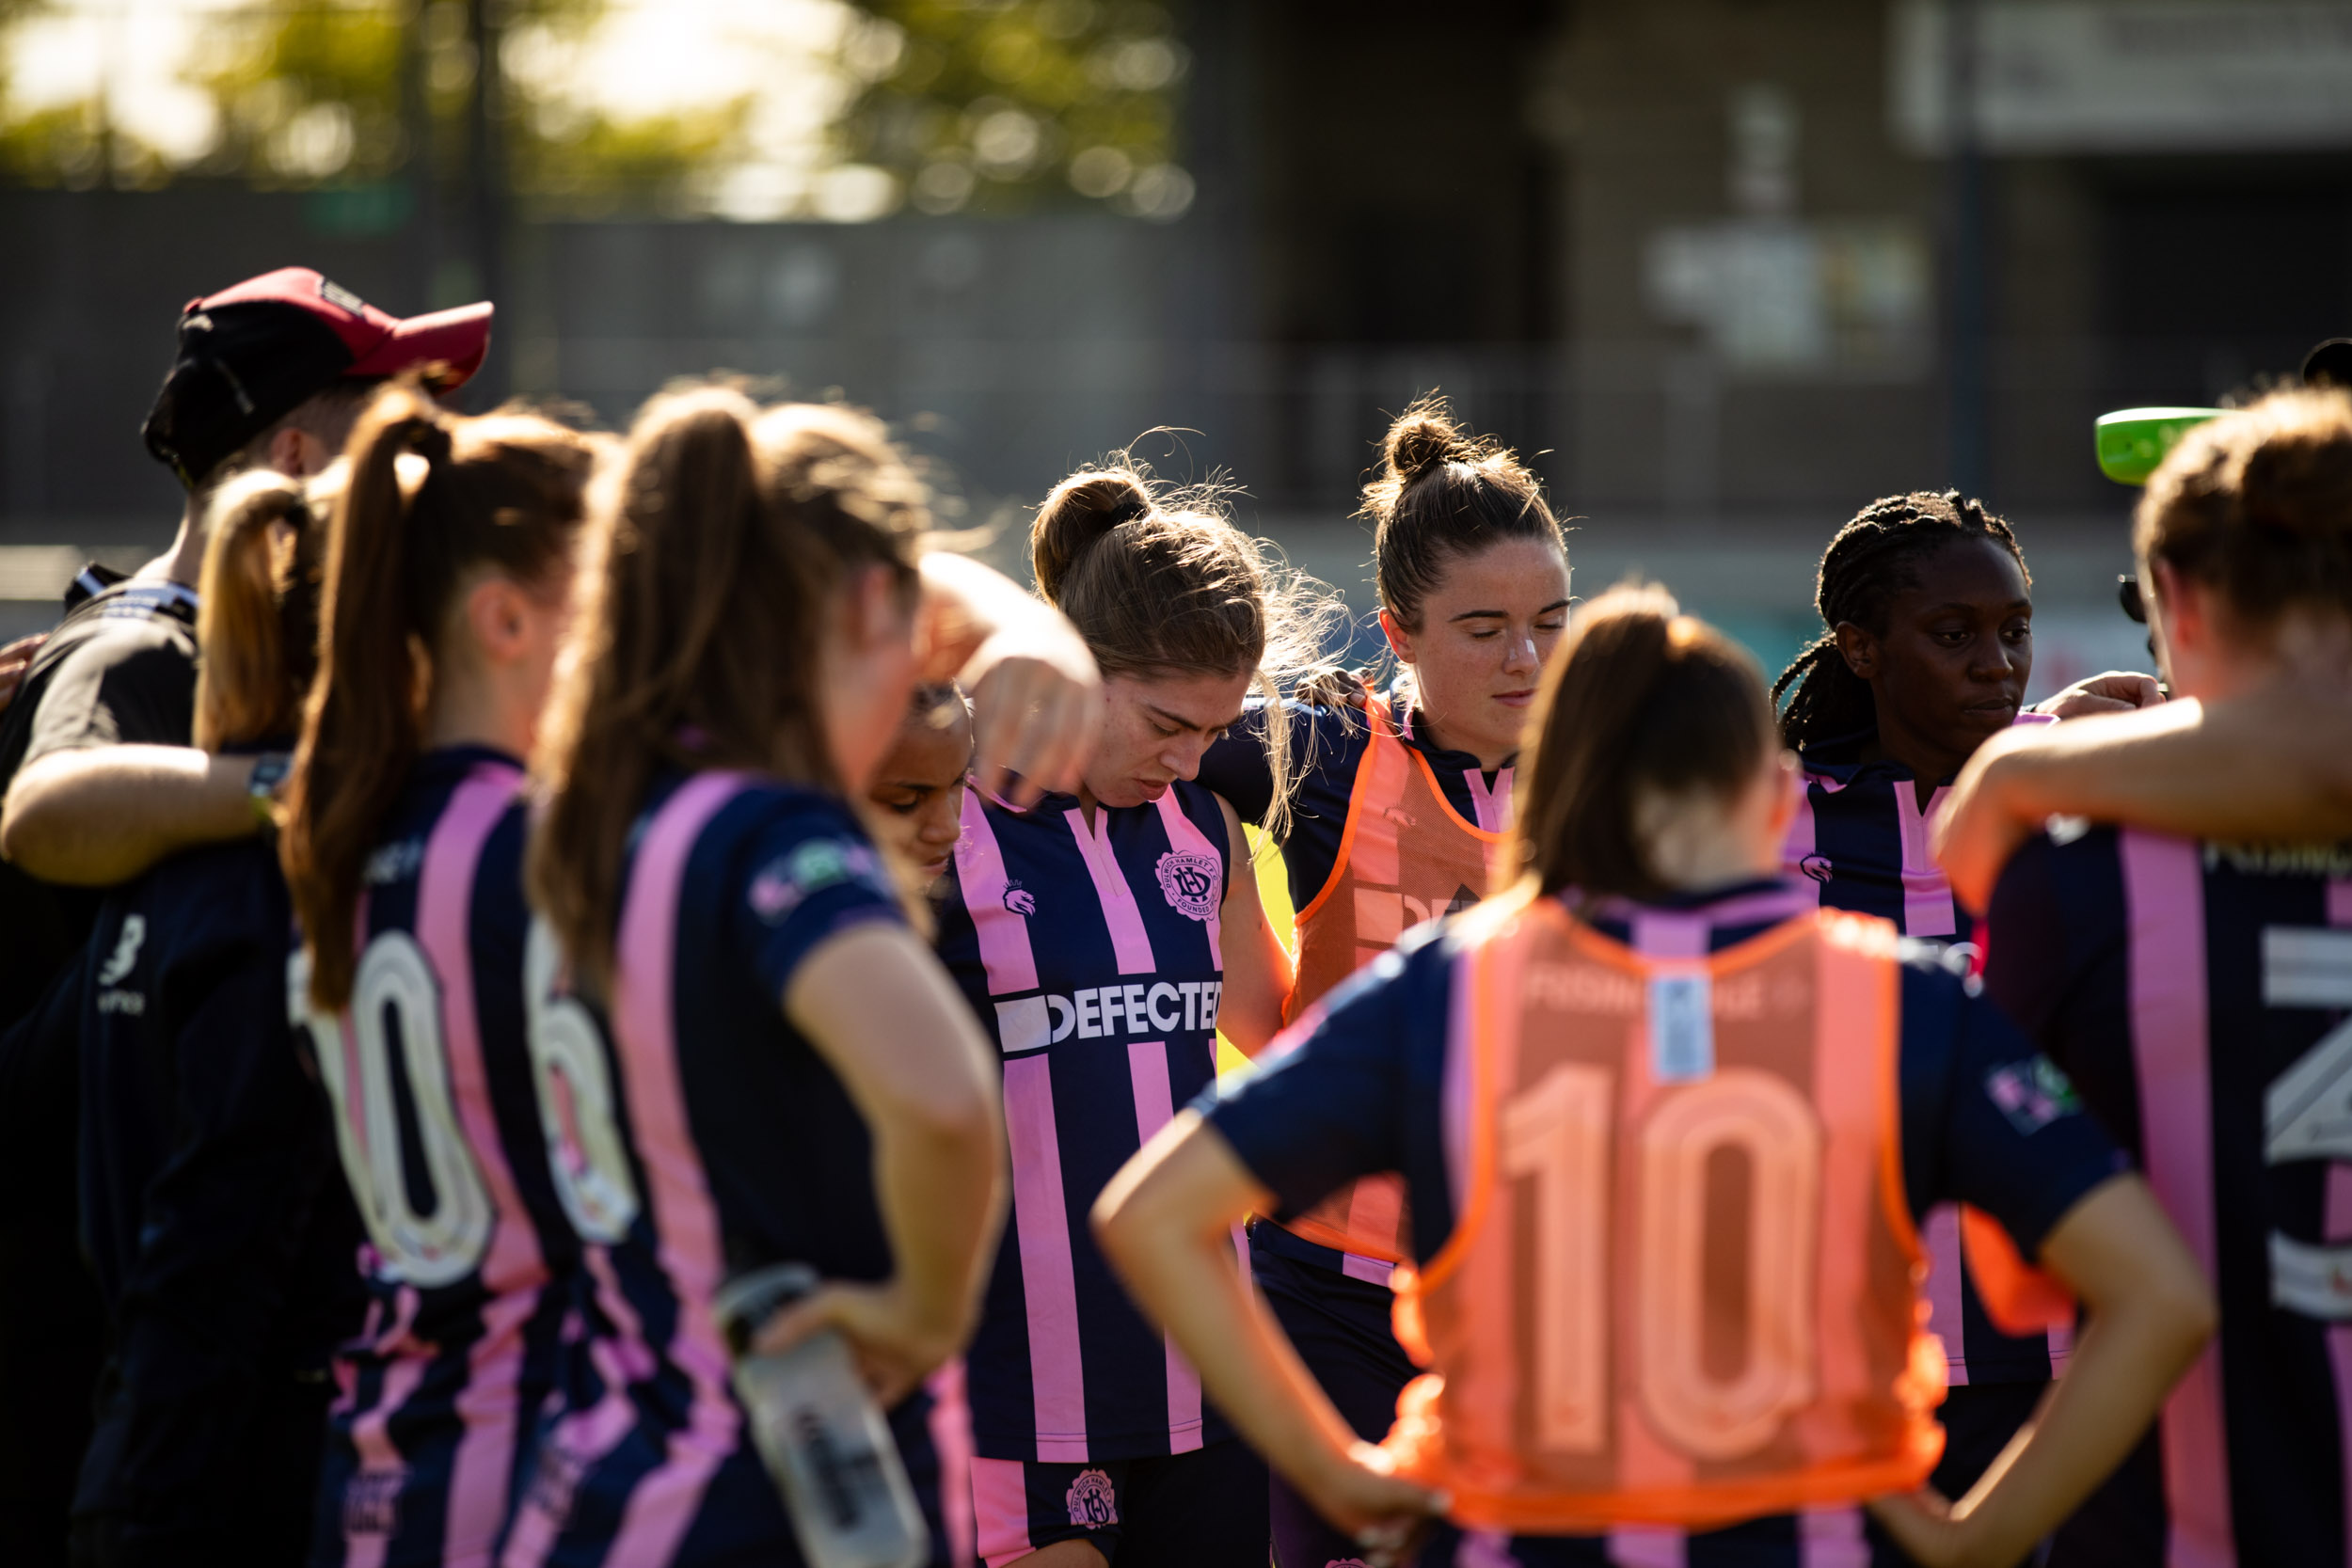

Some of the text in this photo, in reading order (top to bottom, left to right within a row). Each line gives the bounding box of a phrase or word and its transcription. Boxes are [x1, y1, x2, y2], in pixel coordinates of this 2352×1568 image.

[1164, 860, 1175, 889] DULWICH
[1175, 857, 1209, 867] HAMLET
[1177, 897, 1210, 913] FOUNDED
[1045, 981, 1223, 1044] DEFECTED
[1502, 1061, 1821, 1461] 10
